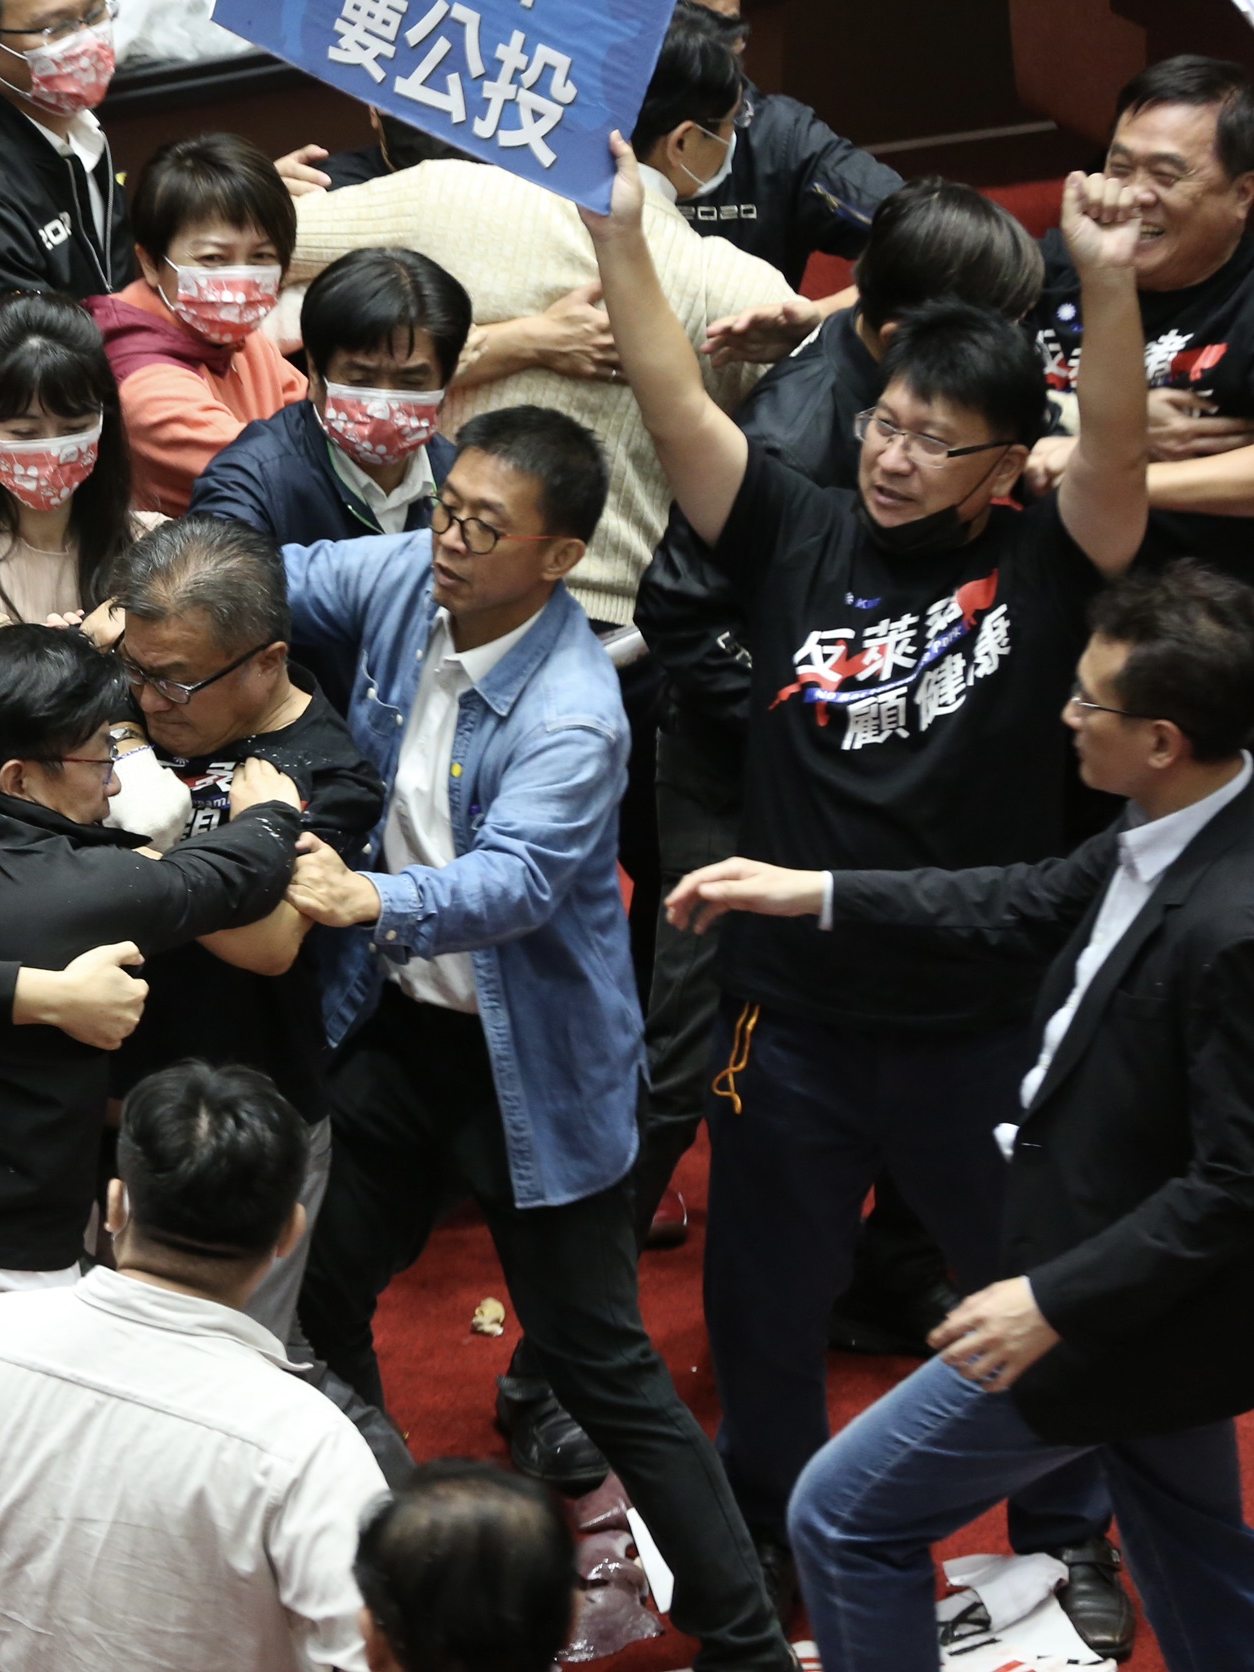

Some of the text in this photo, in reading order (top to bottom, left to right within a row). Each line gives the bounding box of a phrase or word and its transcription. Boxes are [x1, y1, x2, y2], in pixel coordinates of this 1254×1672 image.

[328, 0, 578, 168] 要公投
[841, 603, 1012, 750] 顧健康
